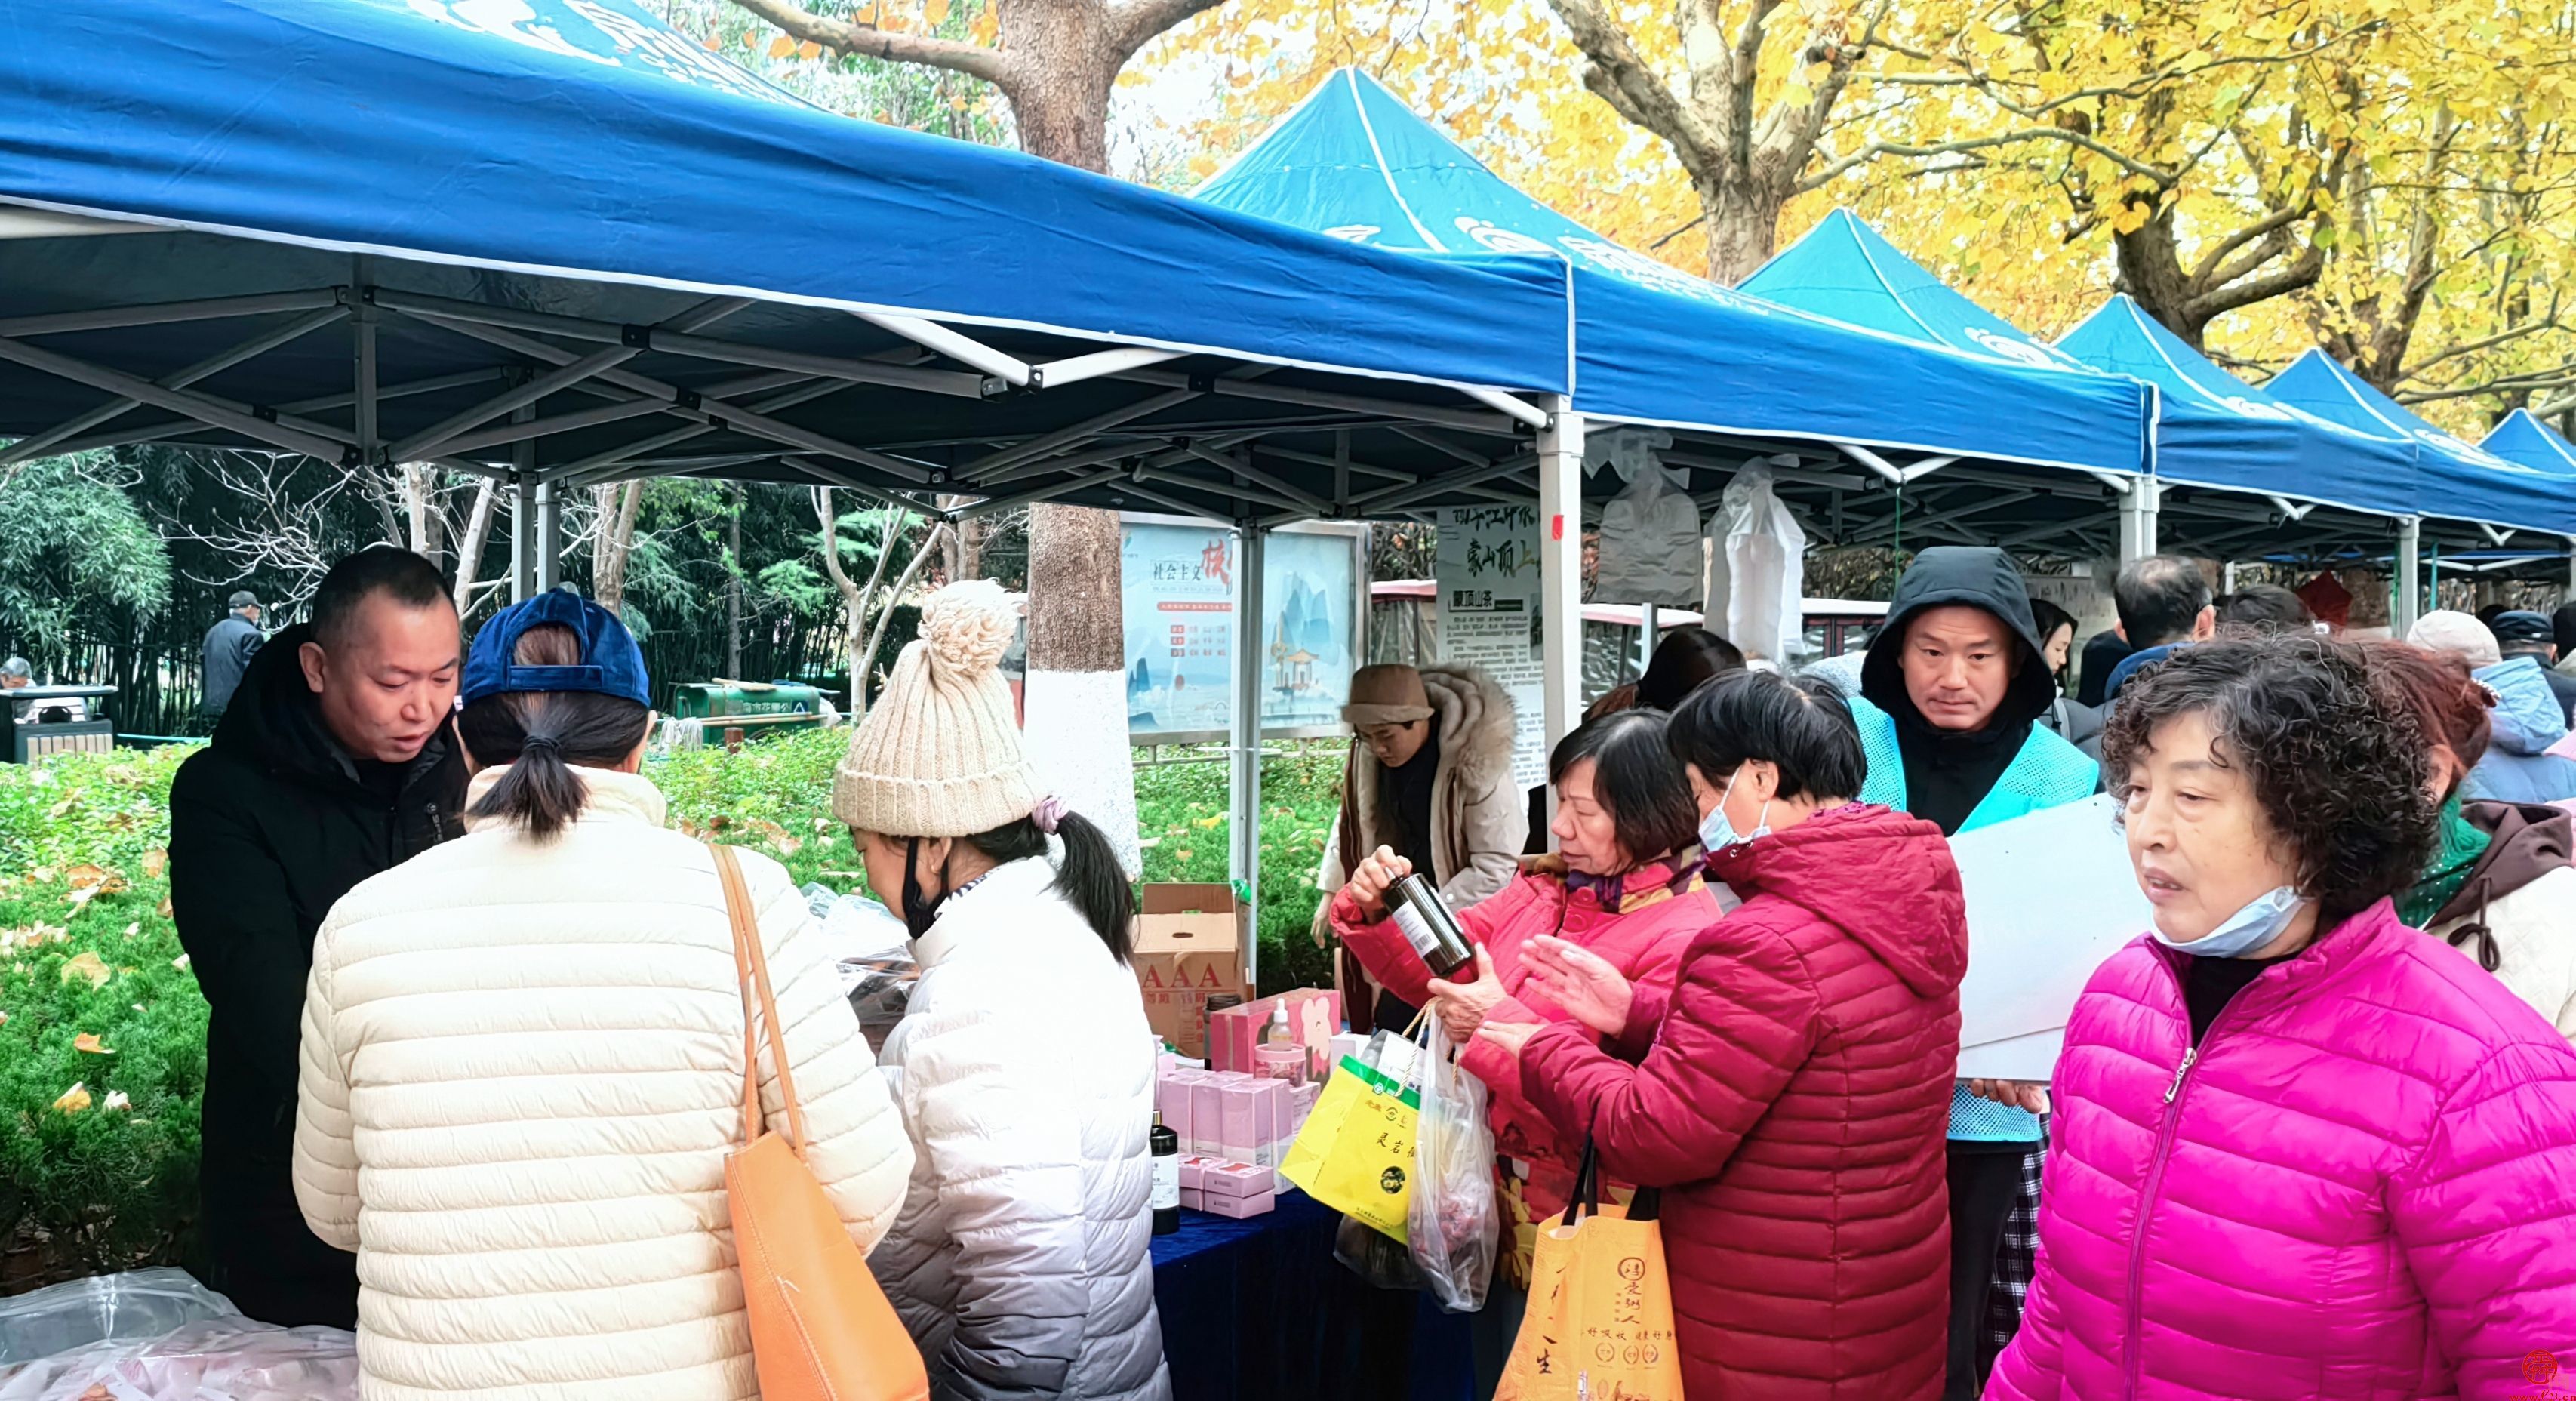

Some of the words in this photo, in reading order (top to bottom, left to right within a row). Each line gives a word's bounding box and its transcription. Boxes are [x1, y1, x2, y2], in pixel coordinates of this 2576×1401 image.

[1154, 562, 1201, 581] 社会主义
[1202, 538, 1232, 585] 核
[1467, 538, 1541, 578] 蒙山顶上
